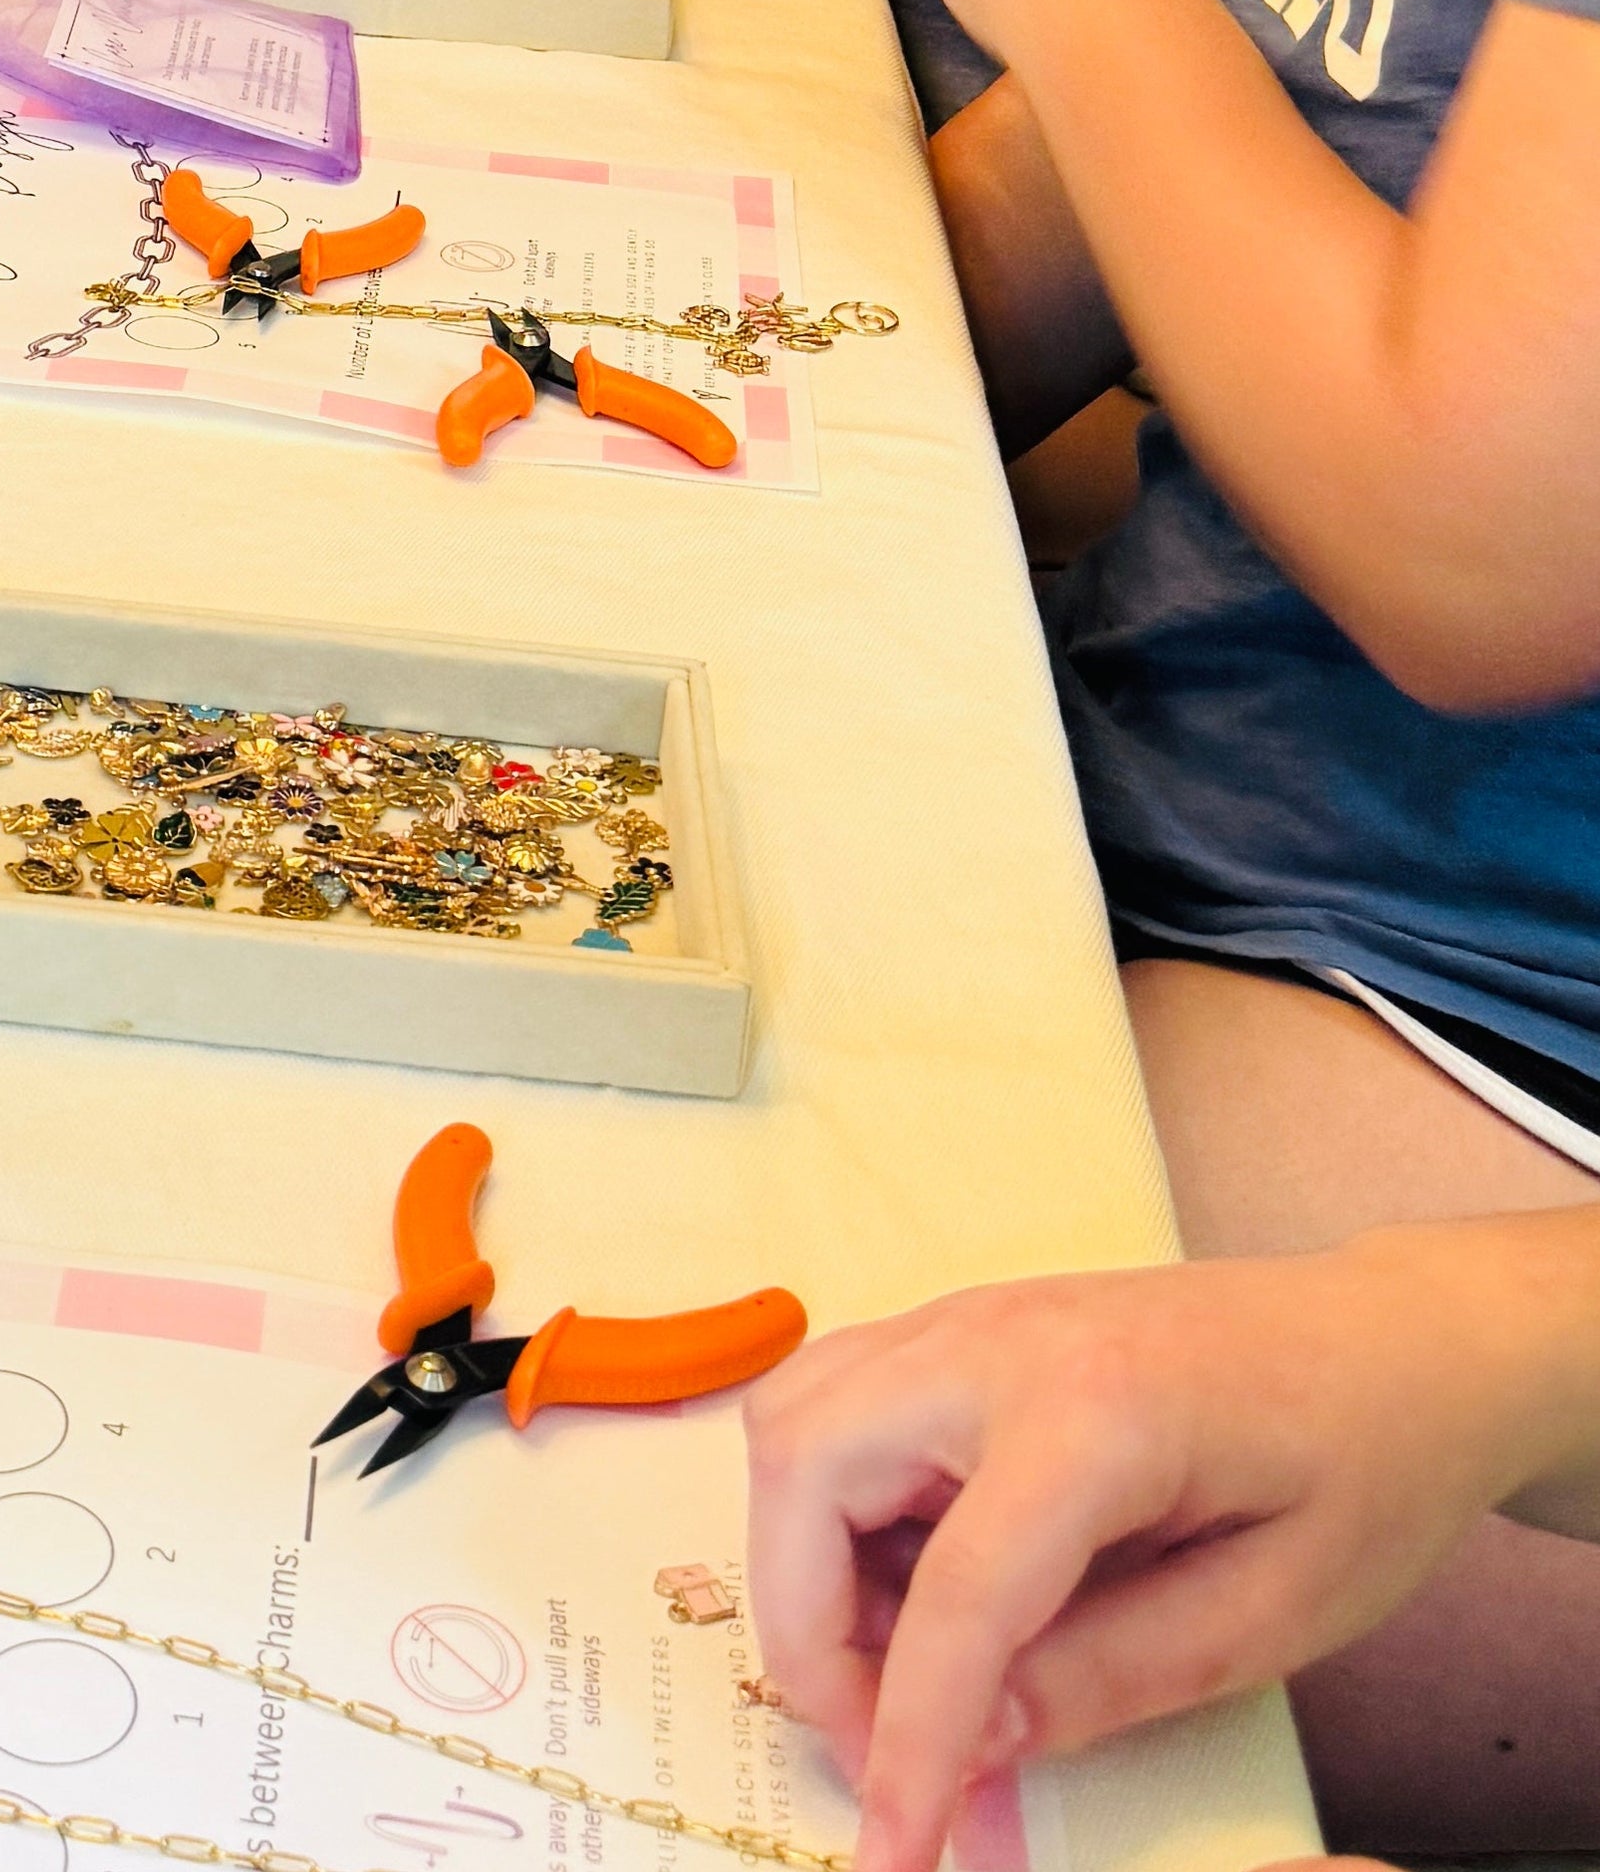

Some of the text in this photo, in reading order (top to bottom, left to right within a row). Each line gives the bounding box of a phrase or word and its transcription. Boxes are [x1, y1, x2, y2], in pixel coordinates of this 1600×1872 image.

[102, 1422, 131, 1437] 4
[145, 1546, 177, 1564] 2
[255, 1544, 300, 1673] Charms:
[546, 1598, 572, 1650] apart
[544, 1654, 572, 1694] pull
[651, 1635, 673, 1743] TWEEZERS
[173, 1711, 205, 1728] 1
[544, 1697, 567, 1757] Don't
[577, 1634, 606, 1864] other sideways
[654, 1757, 675, 1787] OR
[735, 1762, 757, 1823] EACH
[548, 1796, 573, 1855] away
